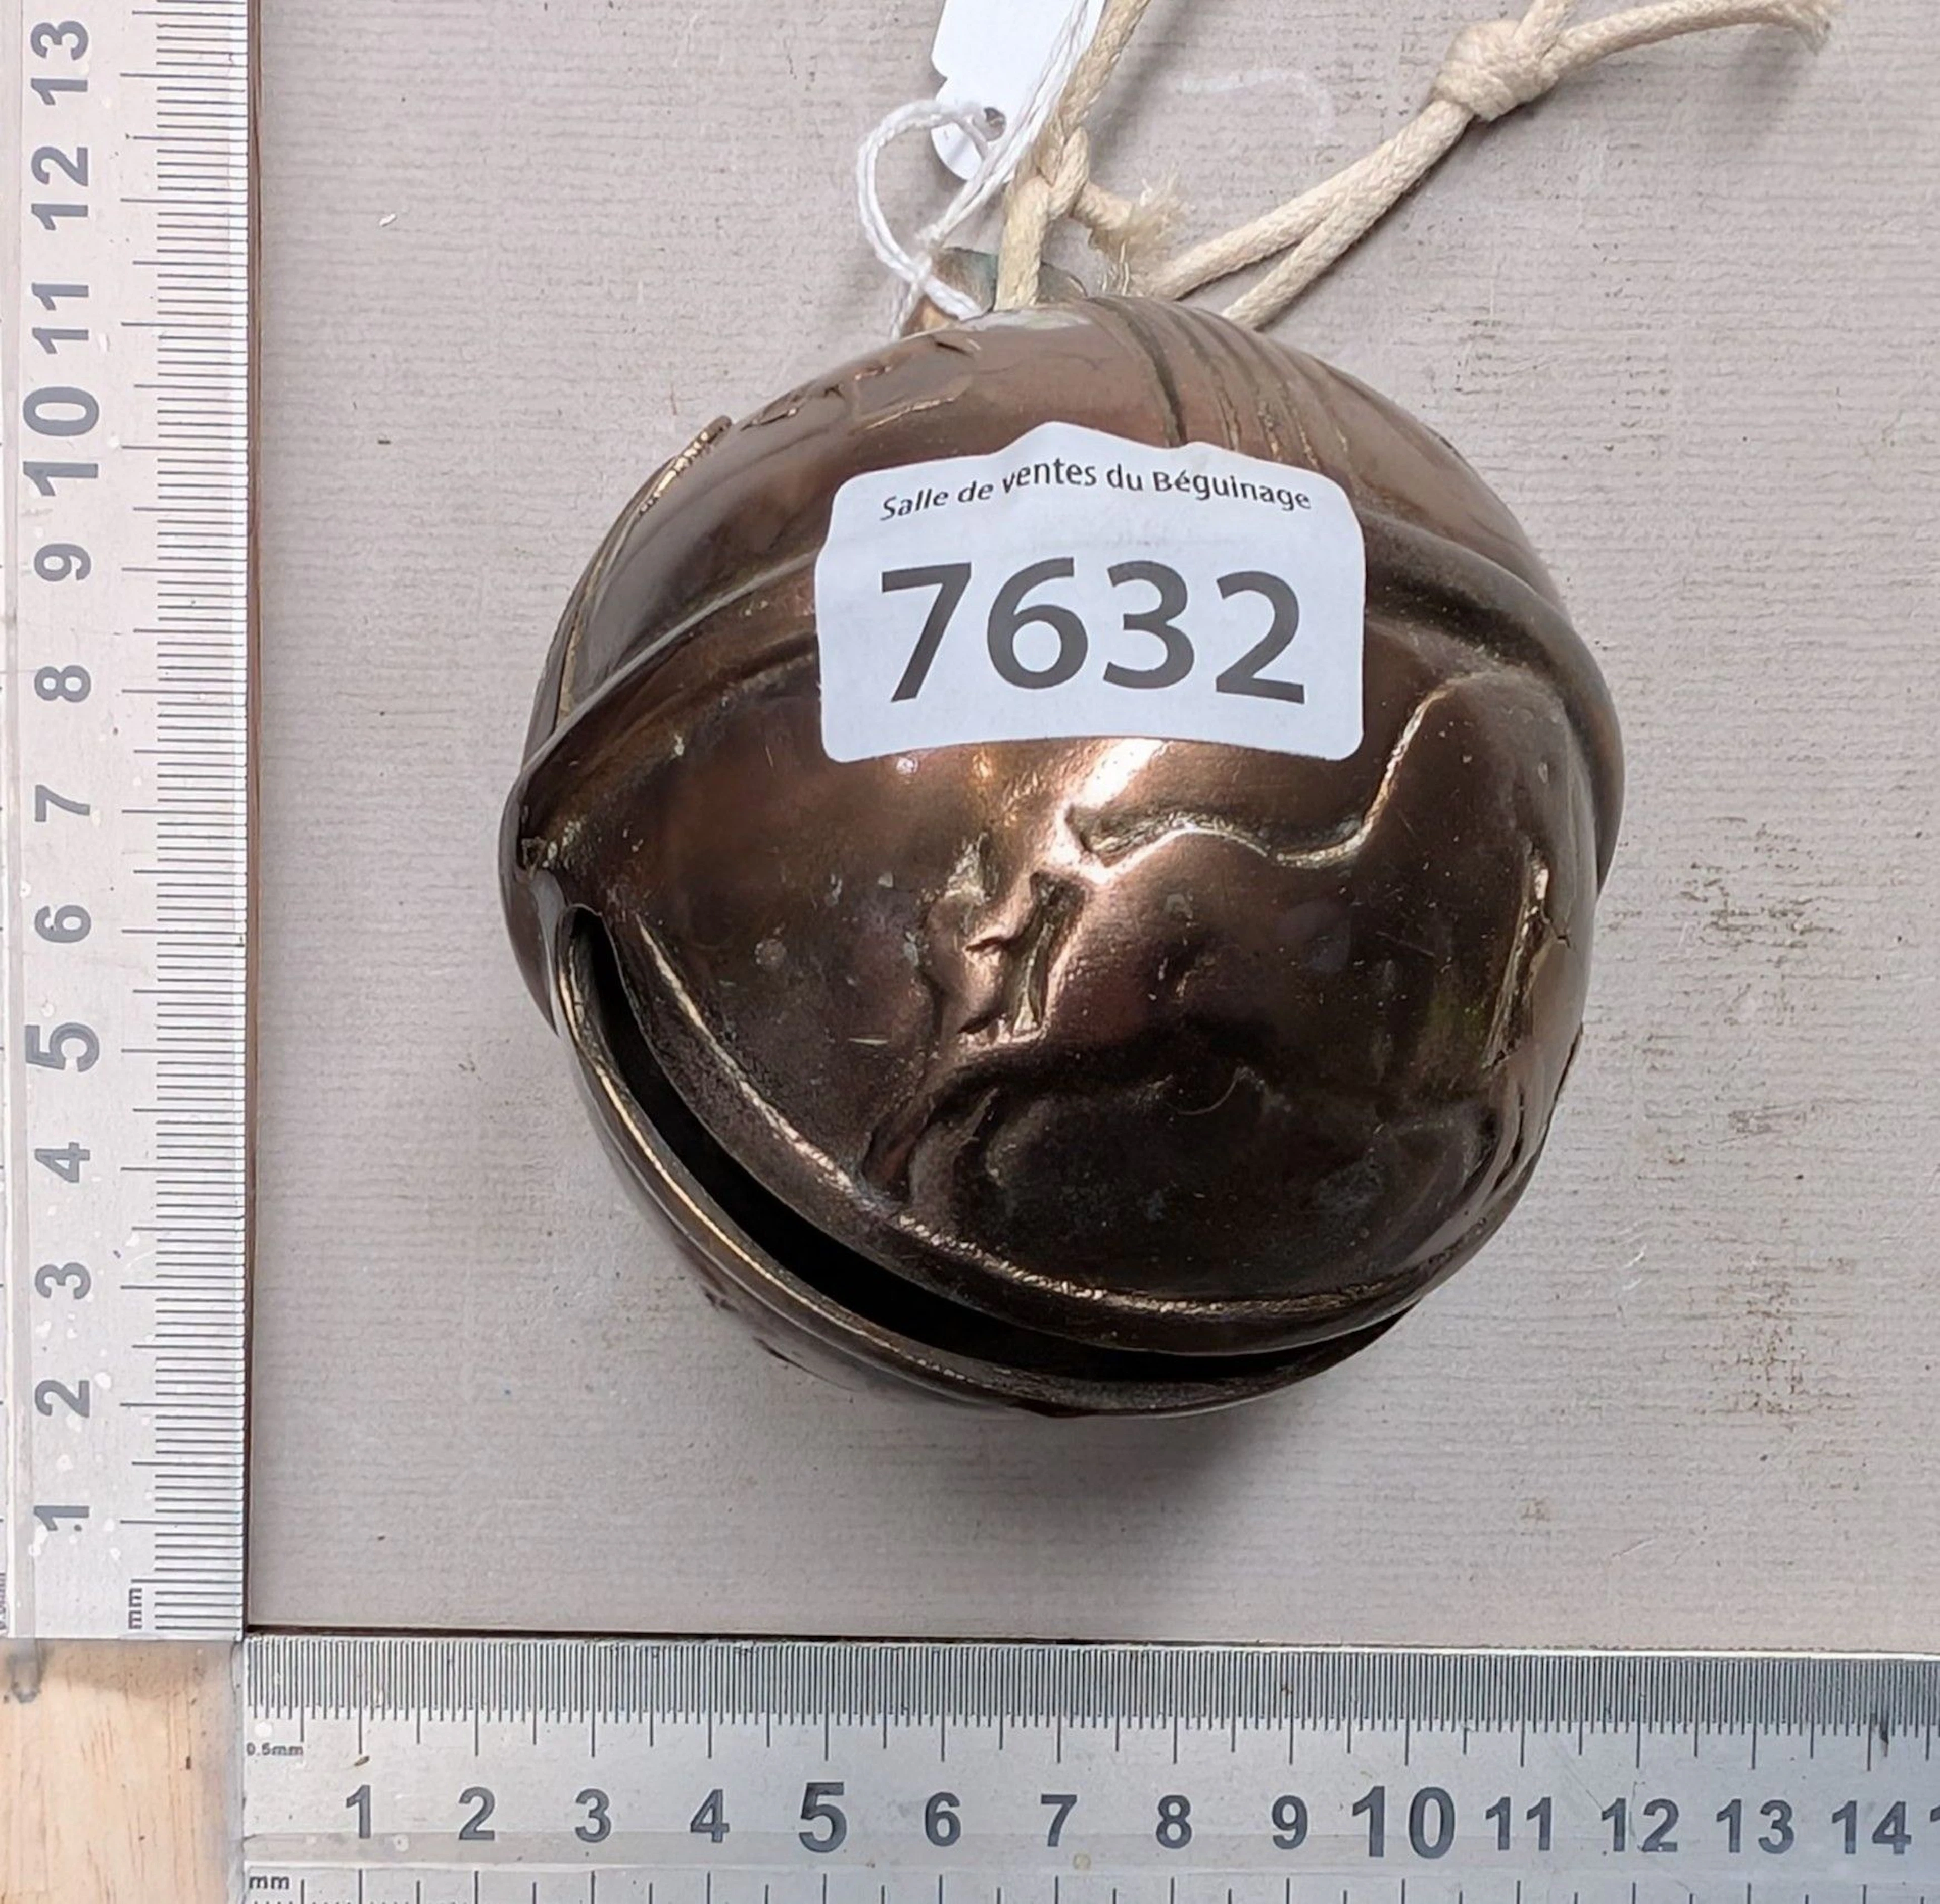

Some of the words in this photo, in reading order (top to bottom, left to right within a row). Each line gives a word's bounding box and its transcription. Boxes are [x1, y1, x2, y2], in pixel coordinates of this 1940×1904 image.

[30, 21, 88, 105] 13
[31, 147, 88, 230] 12
[32, 283, 89, 354] 11
[23, 387, 99, 496] 10
[881, 489, 948, 520] Salle
[958, 481, 993, 503] de
[1003, 458, 1096, 493] ventes
[1107, 464, 1143, 491] du
[1153, 470, 1310, 511] Béguinage
[34, 544, 91, 581] 9
[882, 557, 1304, 704] 7632
[34, 665, 91, 703] 8
[35, 785, 90, 822] 7
[34, 905, 91, 943] 6
[25, 1022, 99, 1072] 5
[34, 1142, 90, 1183] 4
[35, 1263, 91, 1300] 3
[34, 1380, 90, 1419] 2
[33, 1505, 89, 1531] 1
[128, 1588, 142, 1629] mm
[246, 1742, 303, 1756] 0.5mm
[347, 1785, 370, 1838] 1
[459, 1787, 494, 1840] 2
[575, 1789, 611, 1843] 3
[690, 1789, 730, 1843] 4
[799, 1782, 847, 1853] 5
[925, 1792, 960, 1847] 6
[1041, 1794, 1077, 1847] 7
[1156, 1795, 1191, 1849] 8
[1272, 1795, 1307, 1849] 9
[1352, 1786, 1455, 1859] 10
[1486, 1797, 1551, 1851] 11
[1602, 1798, 1679, 1853] 12
[1716, 1799, 1794, 1854] 13
[1832, 1800, 1911, 1854] 14
[249, 1876, 289, 1890] mm
